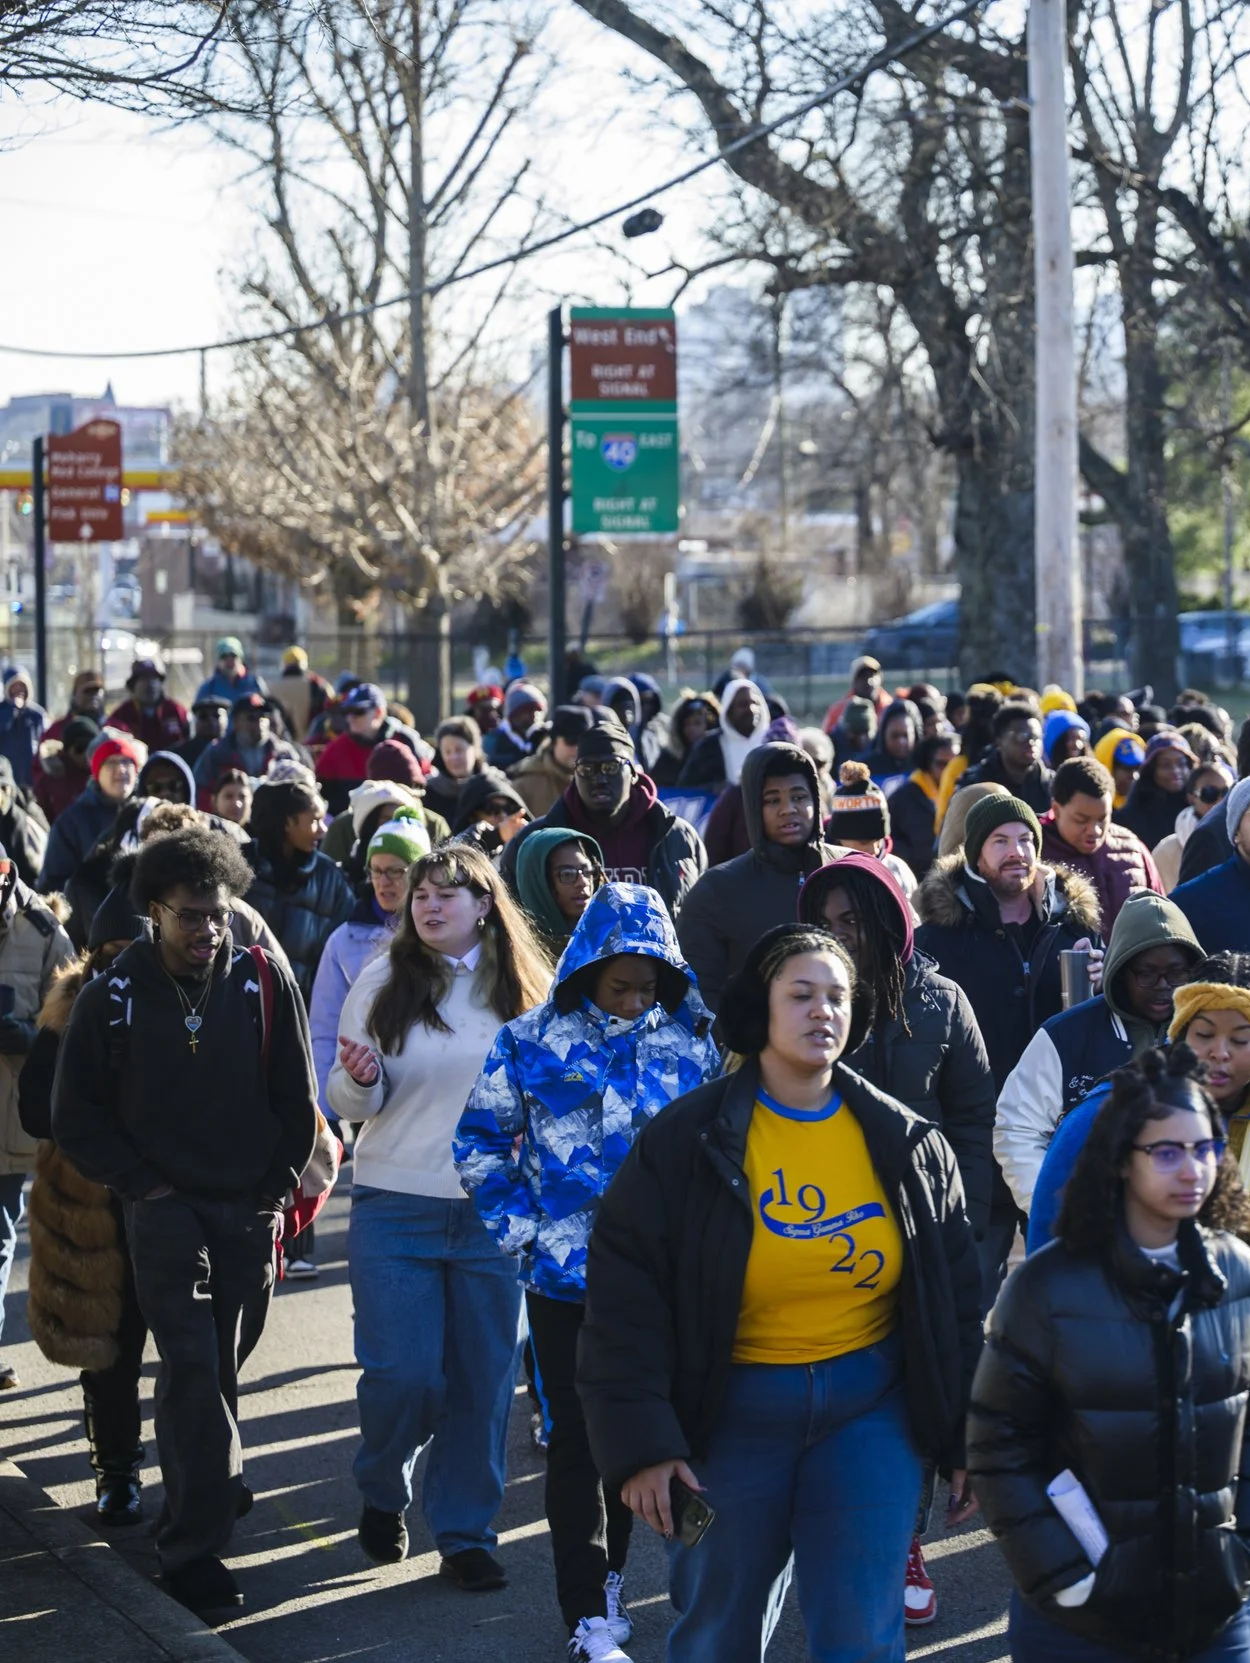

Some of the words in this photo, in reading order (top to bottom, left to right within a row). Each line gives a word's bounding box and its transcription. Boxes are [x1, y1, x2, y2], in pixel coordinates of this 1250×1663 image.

[573, 327, 618, 346] West
[624, 327, 658, 346] End
[591, 364, 633, 379] RIGHT
[638, 364, 657, 379] AT
[599, 381, 649, 397] SIGNAL
[575, 430, 596, 449] To
[593, 497, 635, 512] RIGHT
[639, 497, 658, 512] AT
[601, 514, 651, 530] SIGNAL
[771, 1168, 826, 1223] 19
[783, 1225, 811, 1238] Sigma
[811, 1219, 844, 1238] Gamma
[845, 1210, 865, 1224] Rho
[828, 1232, 885, 1290] 22
